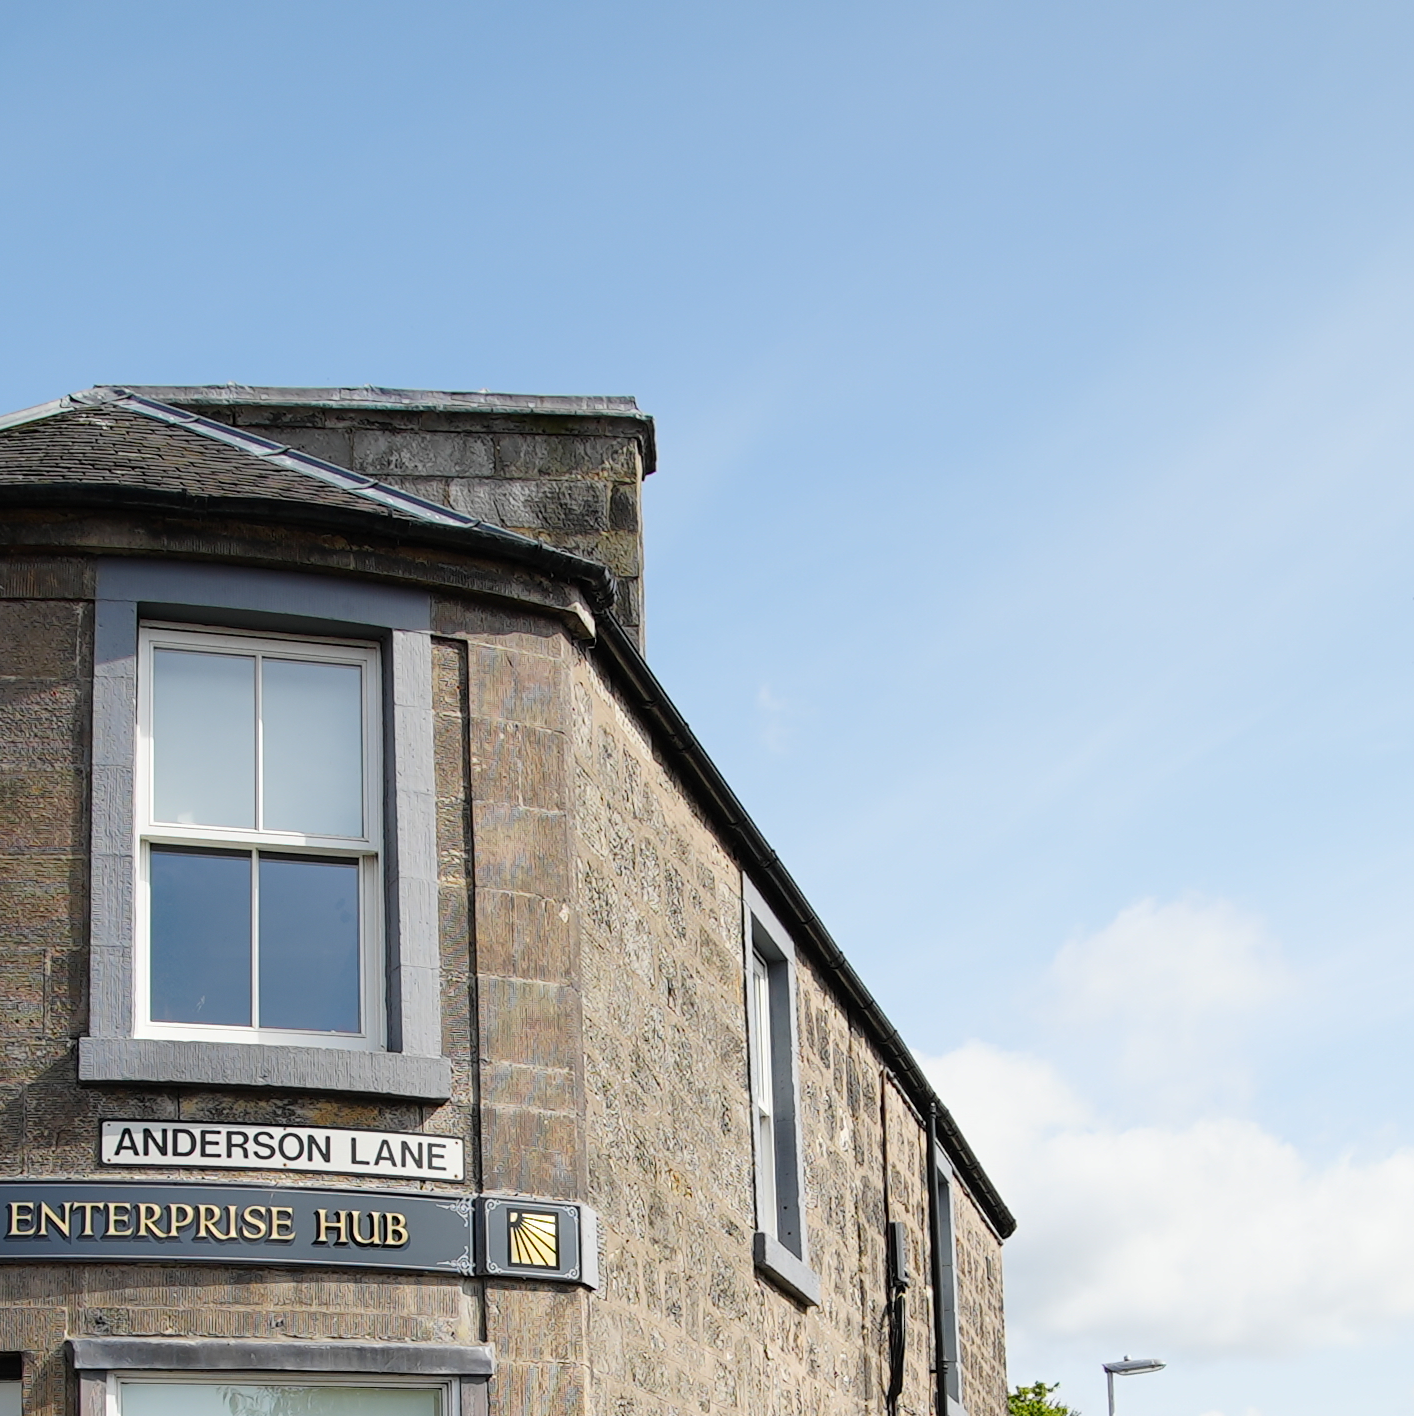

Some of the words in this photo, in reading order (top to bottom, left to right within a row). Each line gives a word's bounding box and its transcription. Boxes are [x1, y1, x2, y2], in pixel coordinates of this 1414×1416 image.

[113, 1127, 332, 1164] ANDERSON
[349, 1136, 448, 1173] LANE
[7, 1201, 297, 1242] ENTERPRISE
[313, 1207, 410, 1247] HUB
